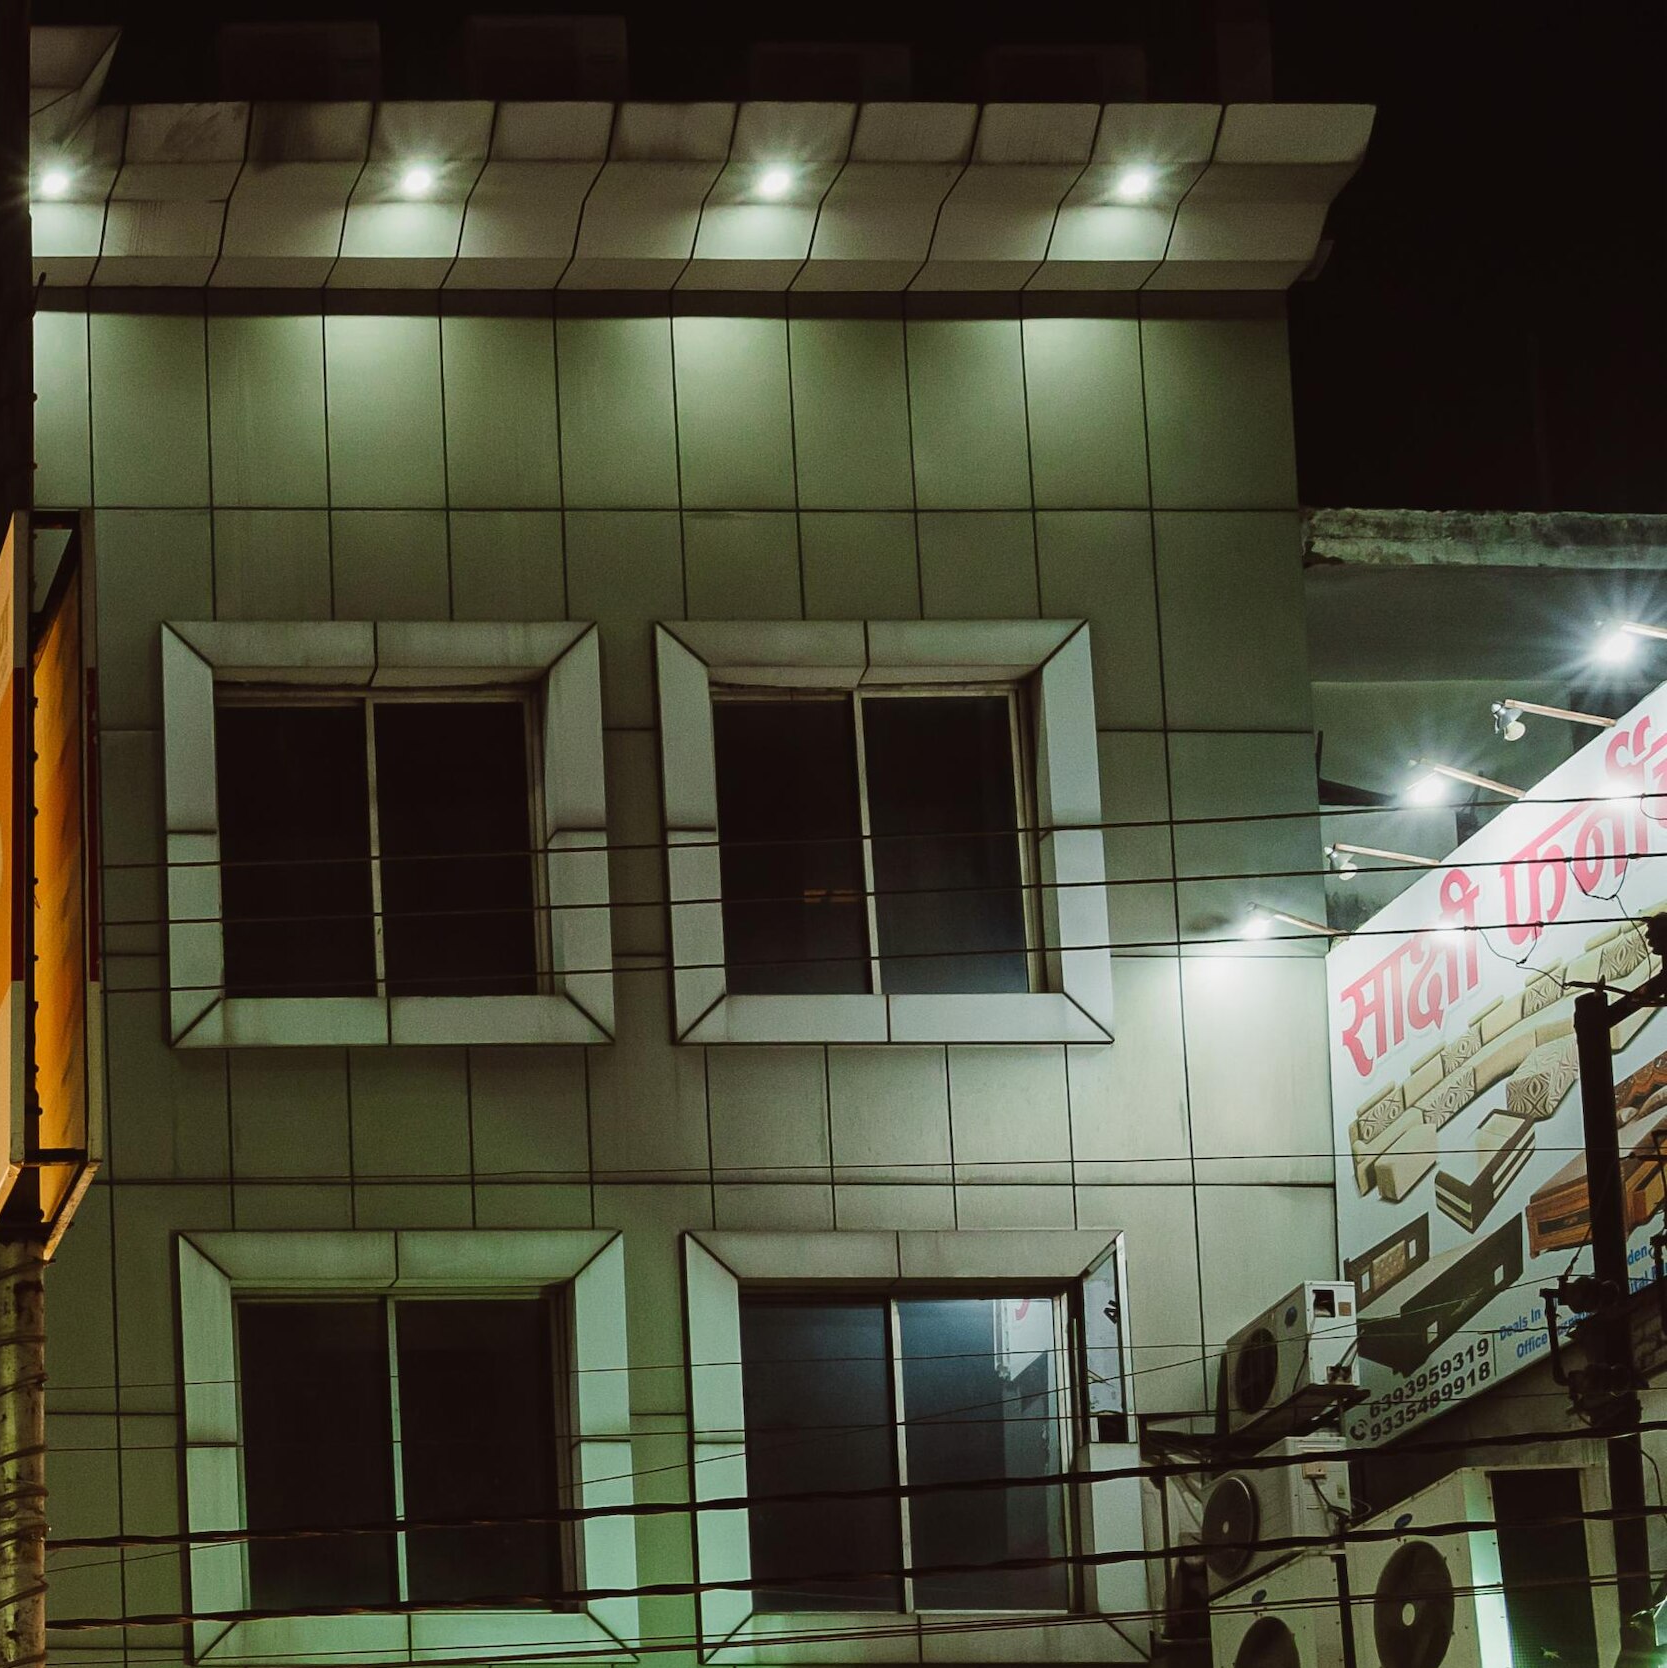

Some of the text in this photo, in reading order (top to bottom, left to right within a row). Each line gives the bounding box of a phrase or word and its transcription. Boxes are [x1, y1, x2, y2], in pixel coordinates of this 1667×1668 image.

[1499, 1316, 1529, 1341] Deals
[1531, 1308, 1541, 1323] In
[1516, 1333, 1548, 1358] Office
[1370, 1338, 1489, 1418] 6393959319
